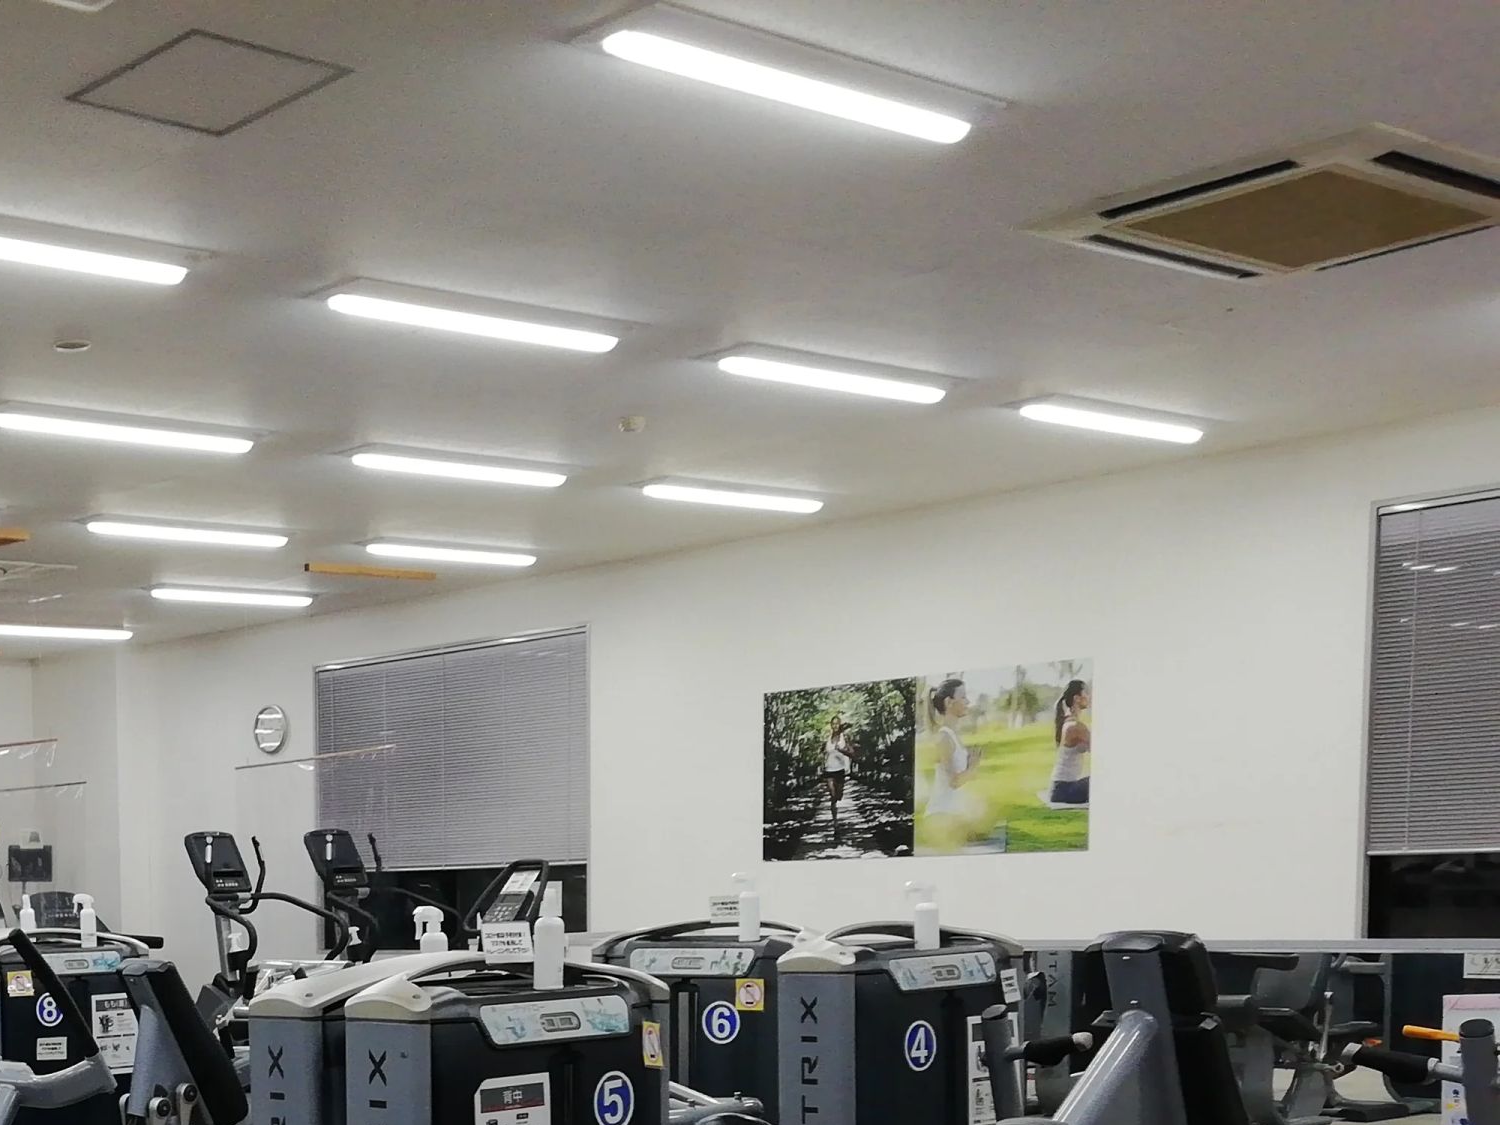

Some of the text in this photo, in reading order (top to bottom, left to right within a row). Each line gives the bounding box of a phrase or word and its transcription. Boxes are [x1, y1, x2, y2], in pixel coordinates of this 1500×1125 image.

[43, 996, 58, 1022] 8
[711, 1006, 731, 1039] 6
[911, 1027, 929, 1063] 4
[502, 1089, 523, 1105] 背中
[603, 1078, 625, 1124] 5
